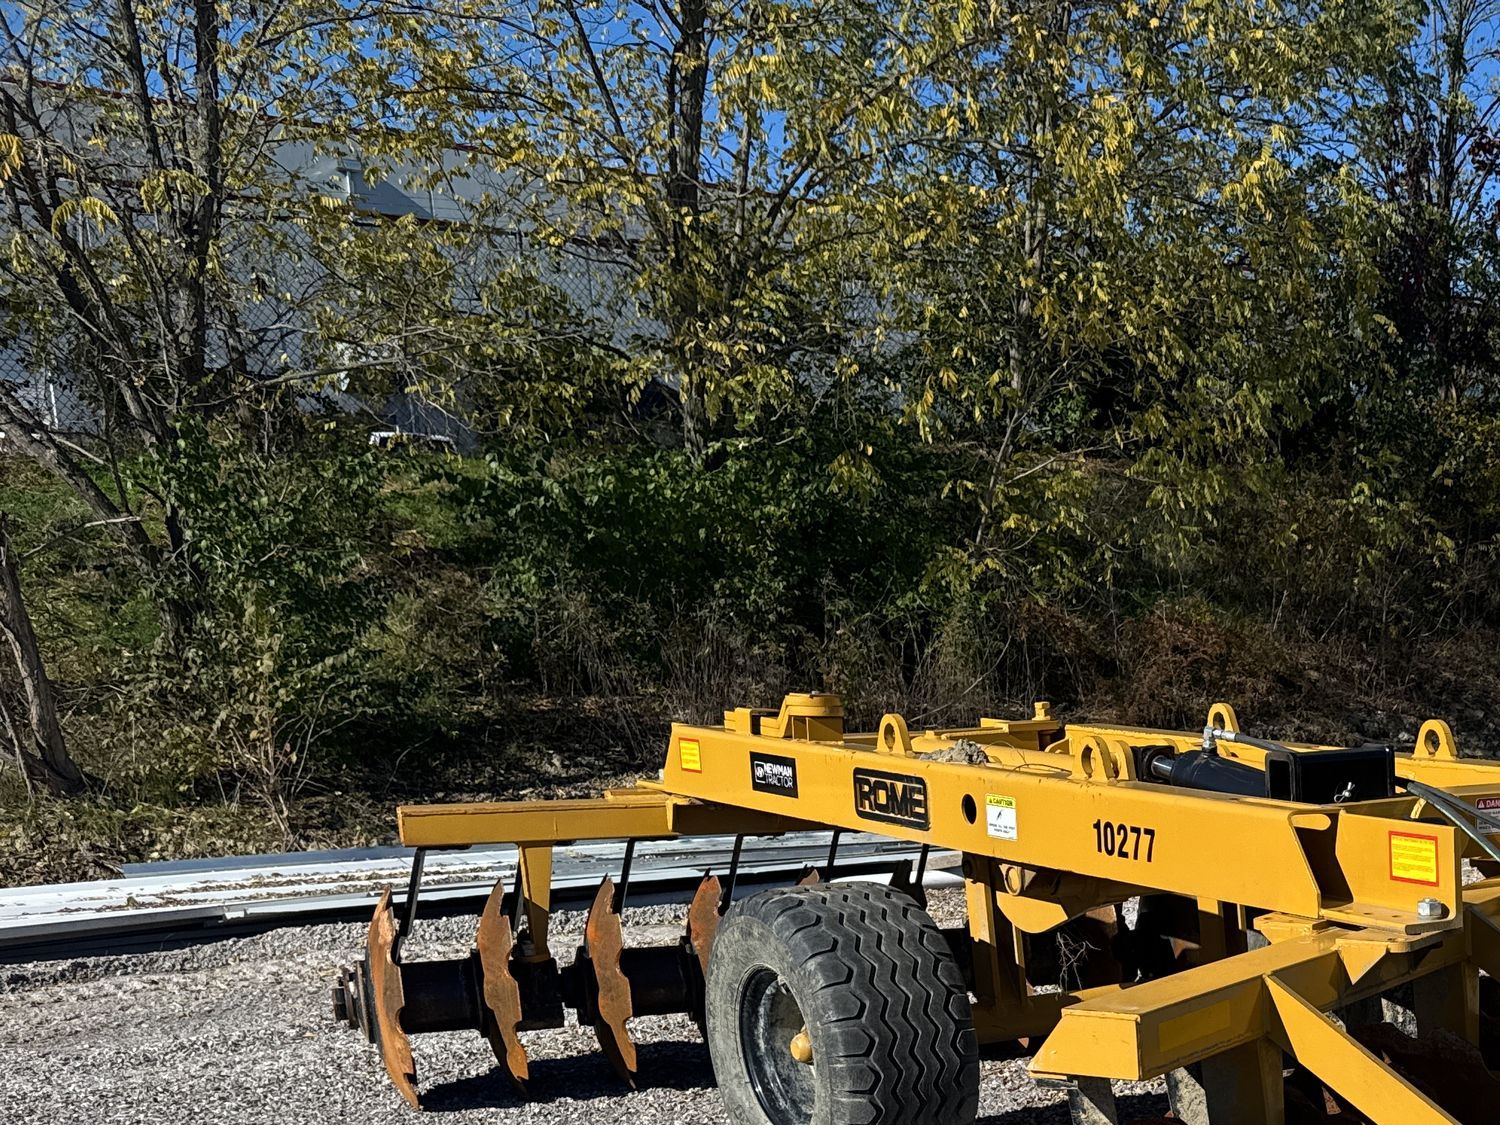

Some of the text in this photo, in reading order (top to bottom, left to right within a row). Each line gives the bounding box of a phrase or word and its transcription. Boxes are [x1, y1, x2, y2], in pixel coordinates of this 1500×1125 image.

[764, 763, 793, 777] NEWMAN
[765, 773, 794, 789] TRACTOR
[855, 777, 928, 820] ROME
[992, 798, 1013, 807] CAUTION
[1092, 818, 1155, 863] 10277
